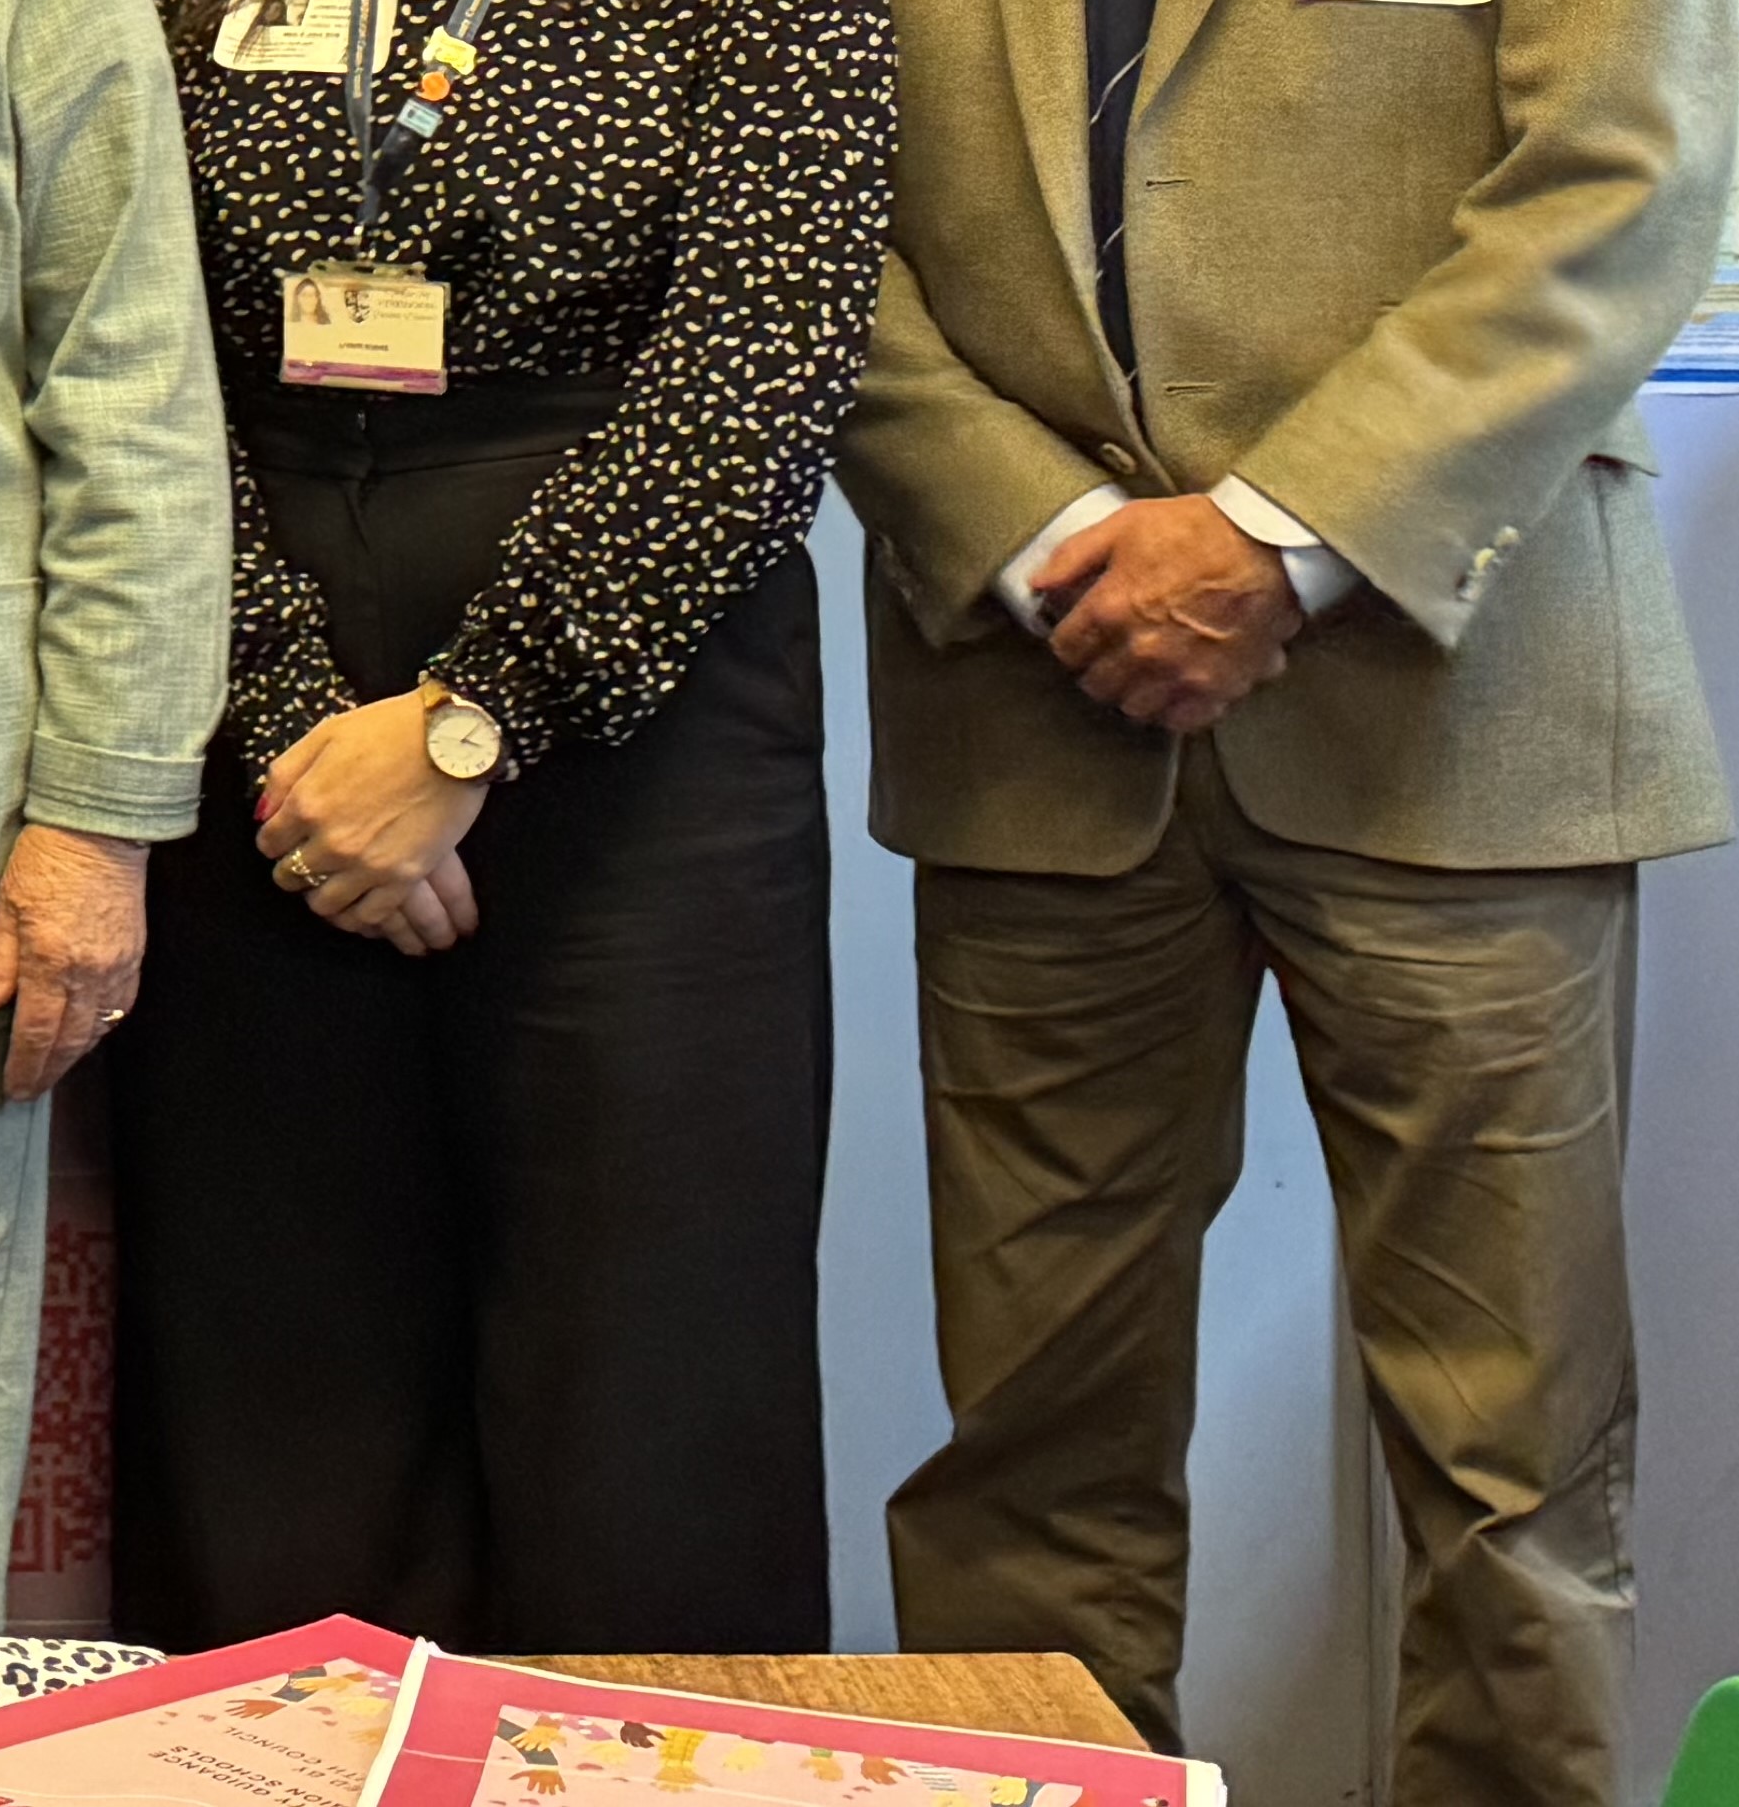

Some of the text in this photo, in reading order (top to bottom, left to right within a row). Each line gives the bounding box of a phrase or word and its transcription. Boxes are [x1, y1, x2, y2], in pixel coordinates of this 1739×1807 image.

[171, 1745, 283, 1787] SCHOOLS
[224, 1726, 322, 1765] COUNCIL
[148, 1750, 272, 1796] GUIDANCE
